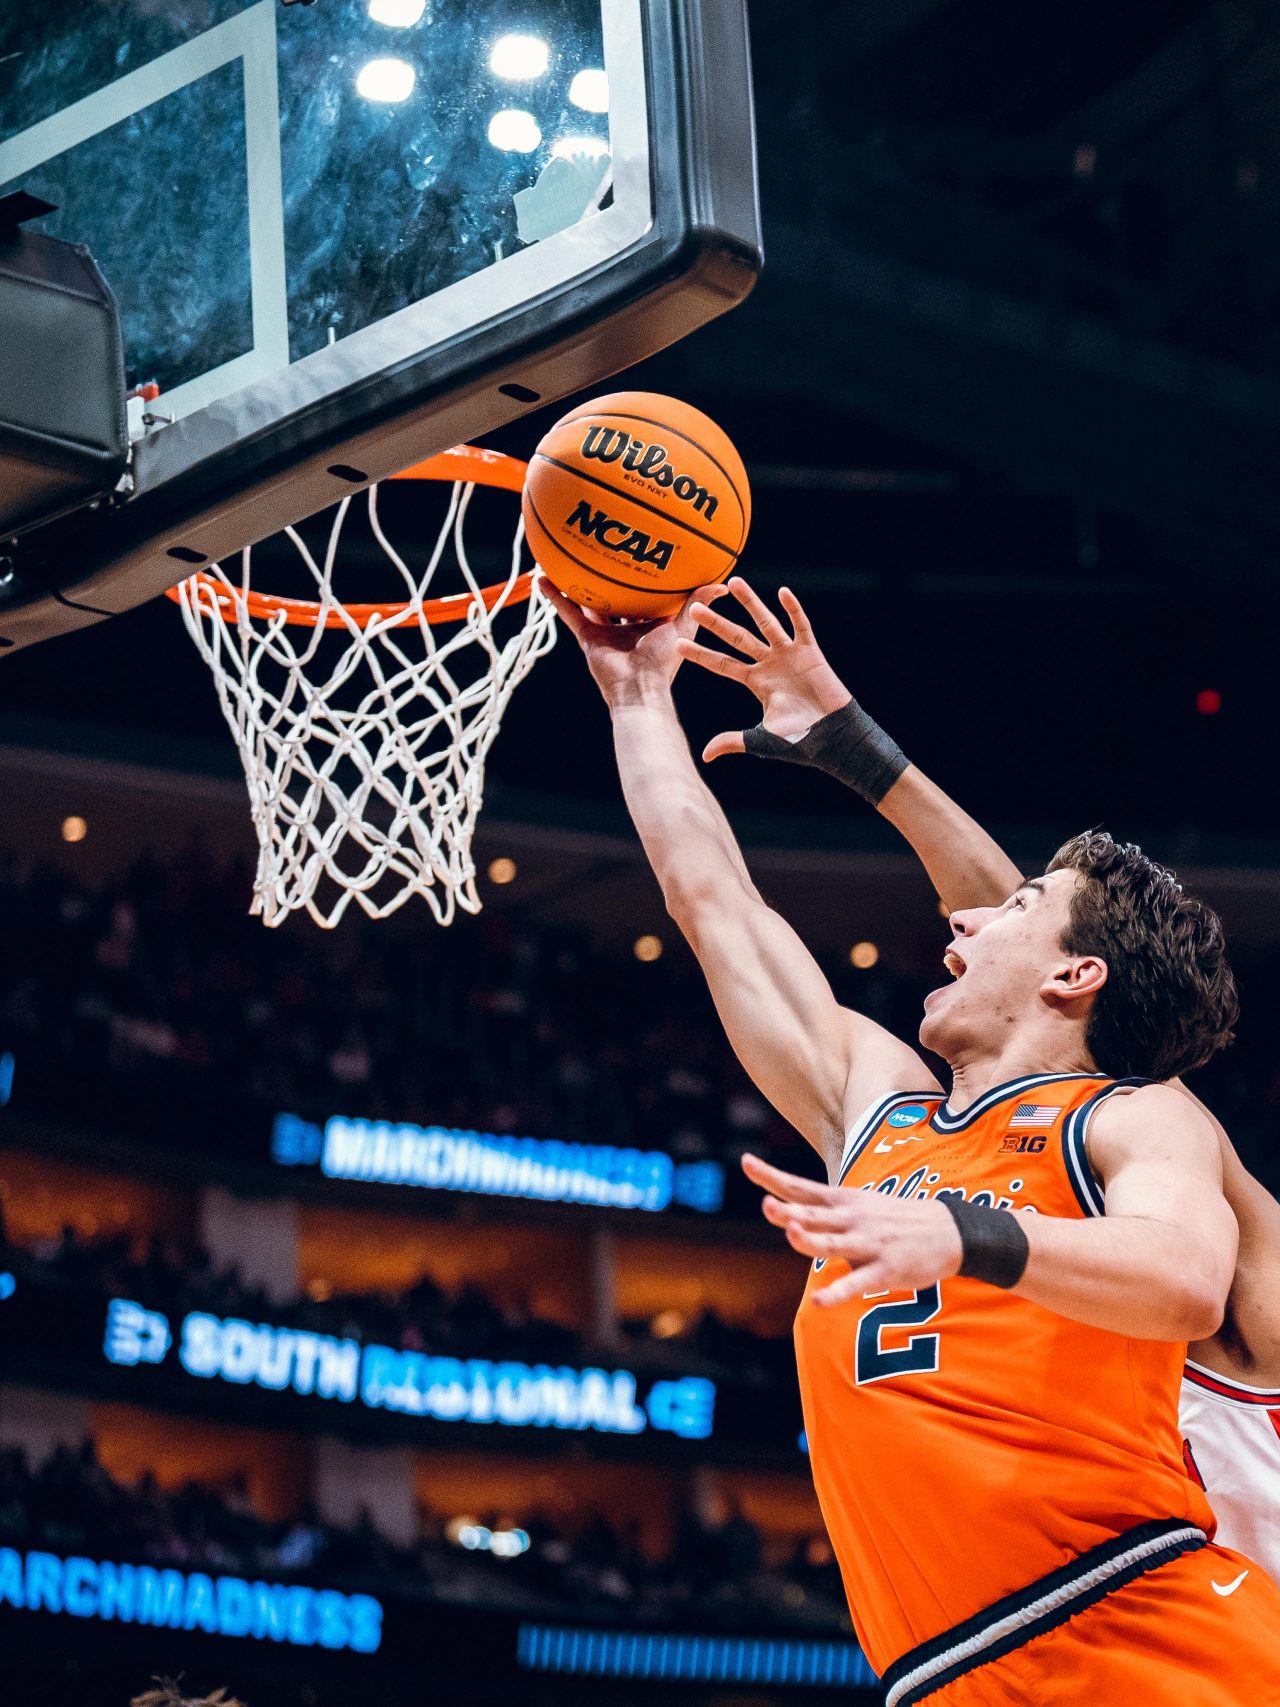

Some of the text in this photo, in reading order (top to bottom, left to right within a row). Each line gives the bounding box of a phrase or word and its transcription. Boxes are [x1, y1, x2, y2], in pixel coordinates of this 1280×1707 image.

[581, 425, 719, 523] Wilson
[623, 473, 668, 499] EVO NXT
[565, 499, 675, 571] NCAA
[602, 551, 632, 569] GAME
[633, 565, 660, 578] BALL
[181, 1312, 647, 1434] SOUTH REGIONAL
[854, 1278, 942, 1386] 2
